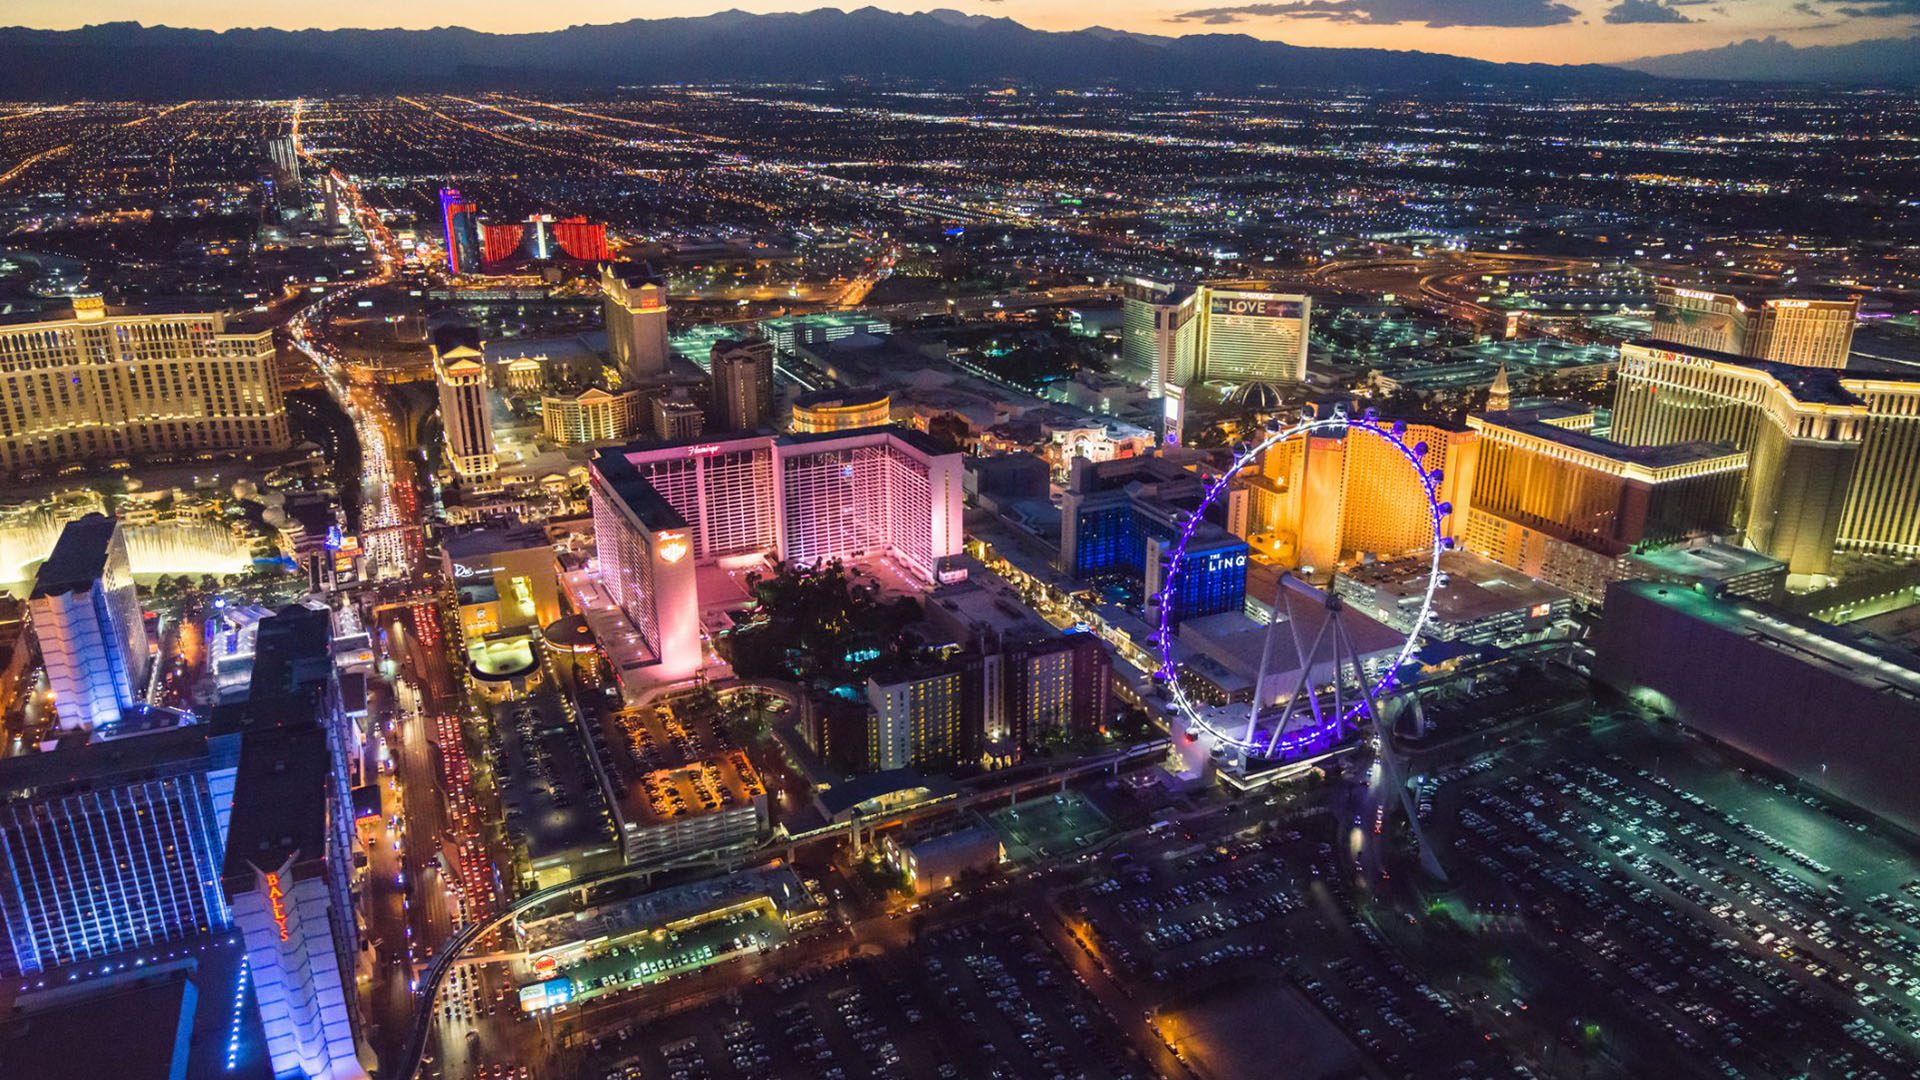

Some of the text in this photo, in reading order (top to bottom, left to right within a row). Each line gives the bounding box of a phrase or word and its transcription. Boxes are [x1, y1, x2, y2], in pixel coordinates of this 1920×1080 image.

[1229, 300, 1266, 313] LOVE
[1653, 349, 1713, 369] VENETIAN
[1209, 555, 1246, 571] LINQ
